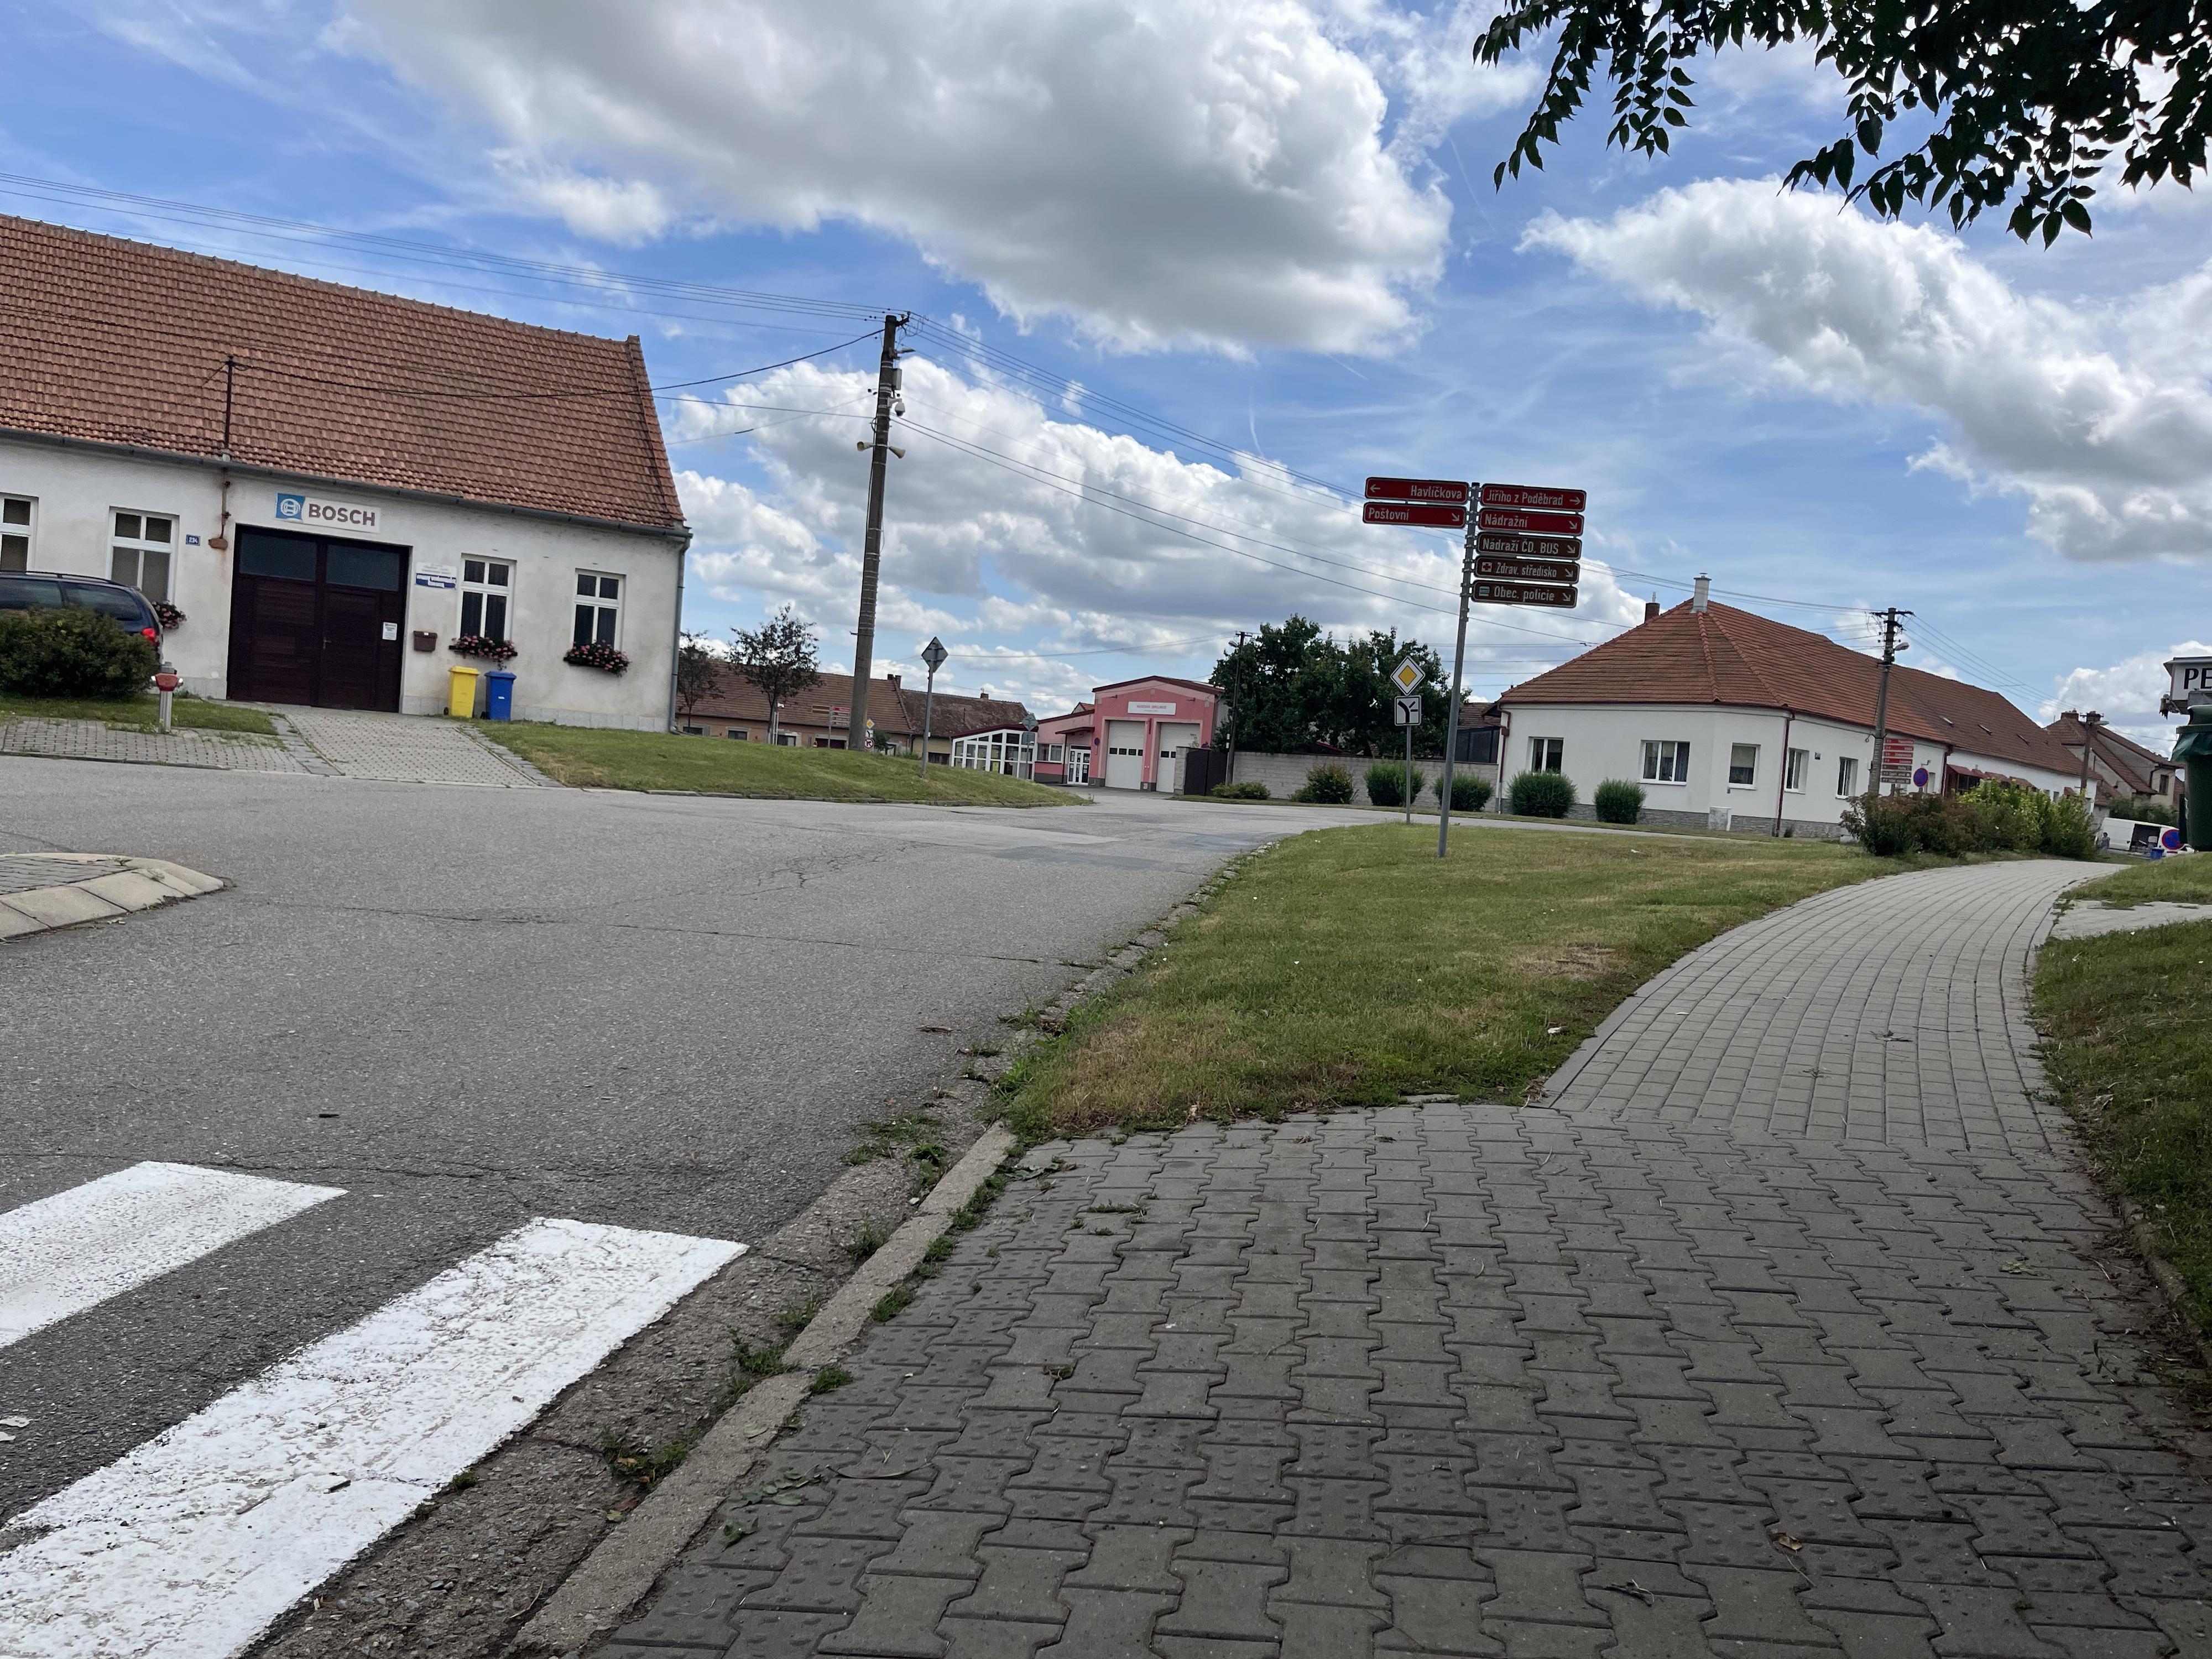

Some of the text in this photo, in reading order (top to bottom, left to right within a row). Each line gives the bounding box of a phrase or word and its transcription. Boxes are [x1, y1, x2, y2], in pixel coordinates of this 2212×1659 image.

[1411, 485, 1462, 499] Havlíčkova
[1486, 489, 1563, 506] Jiřího z Poděbrad
[309, 503, 375, 526] BOSCH
[1368, 508, 1410, 521] Poštovní
[1485, 514, 1528, 528] Nádražní
[1483, 538, 1520, 552] Nádraží
[1540, 542, 1559, 555] BUS
[1522, 564, 1557, 578] středisko
[1494, 586, 1555, 602] Obec. policie
